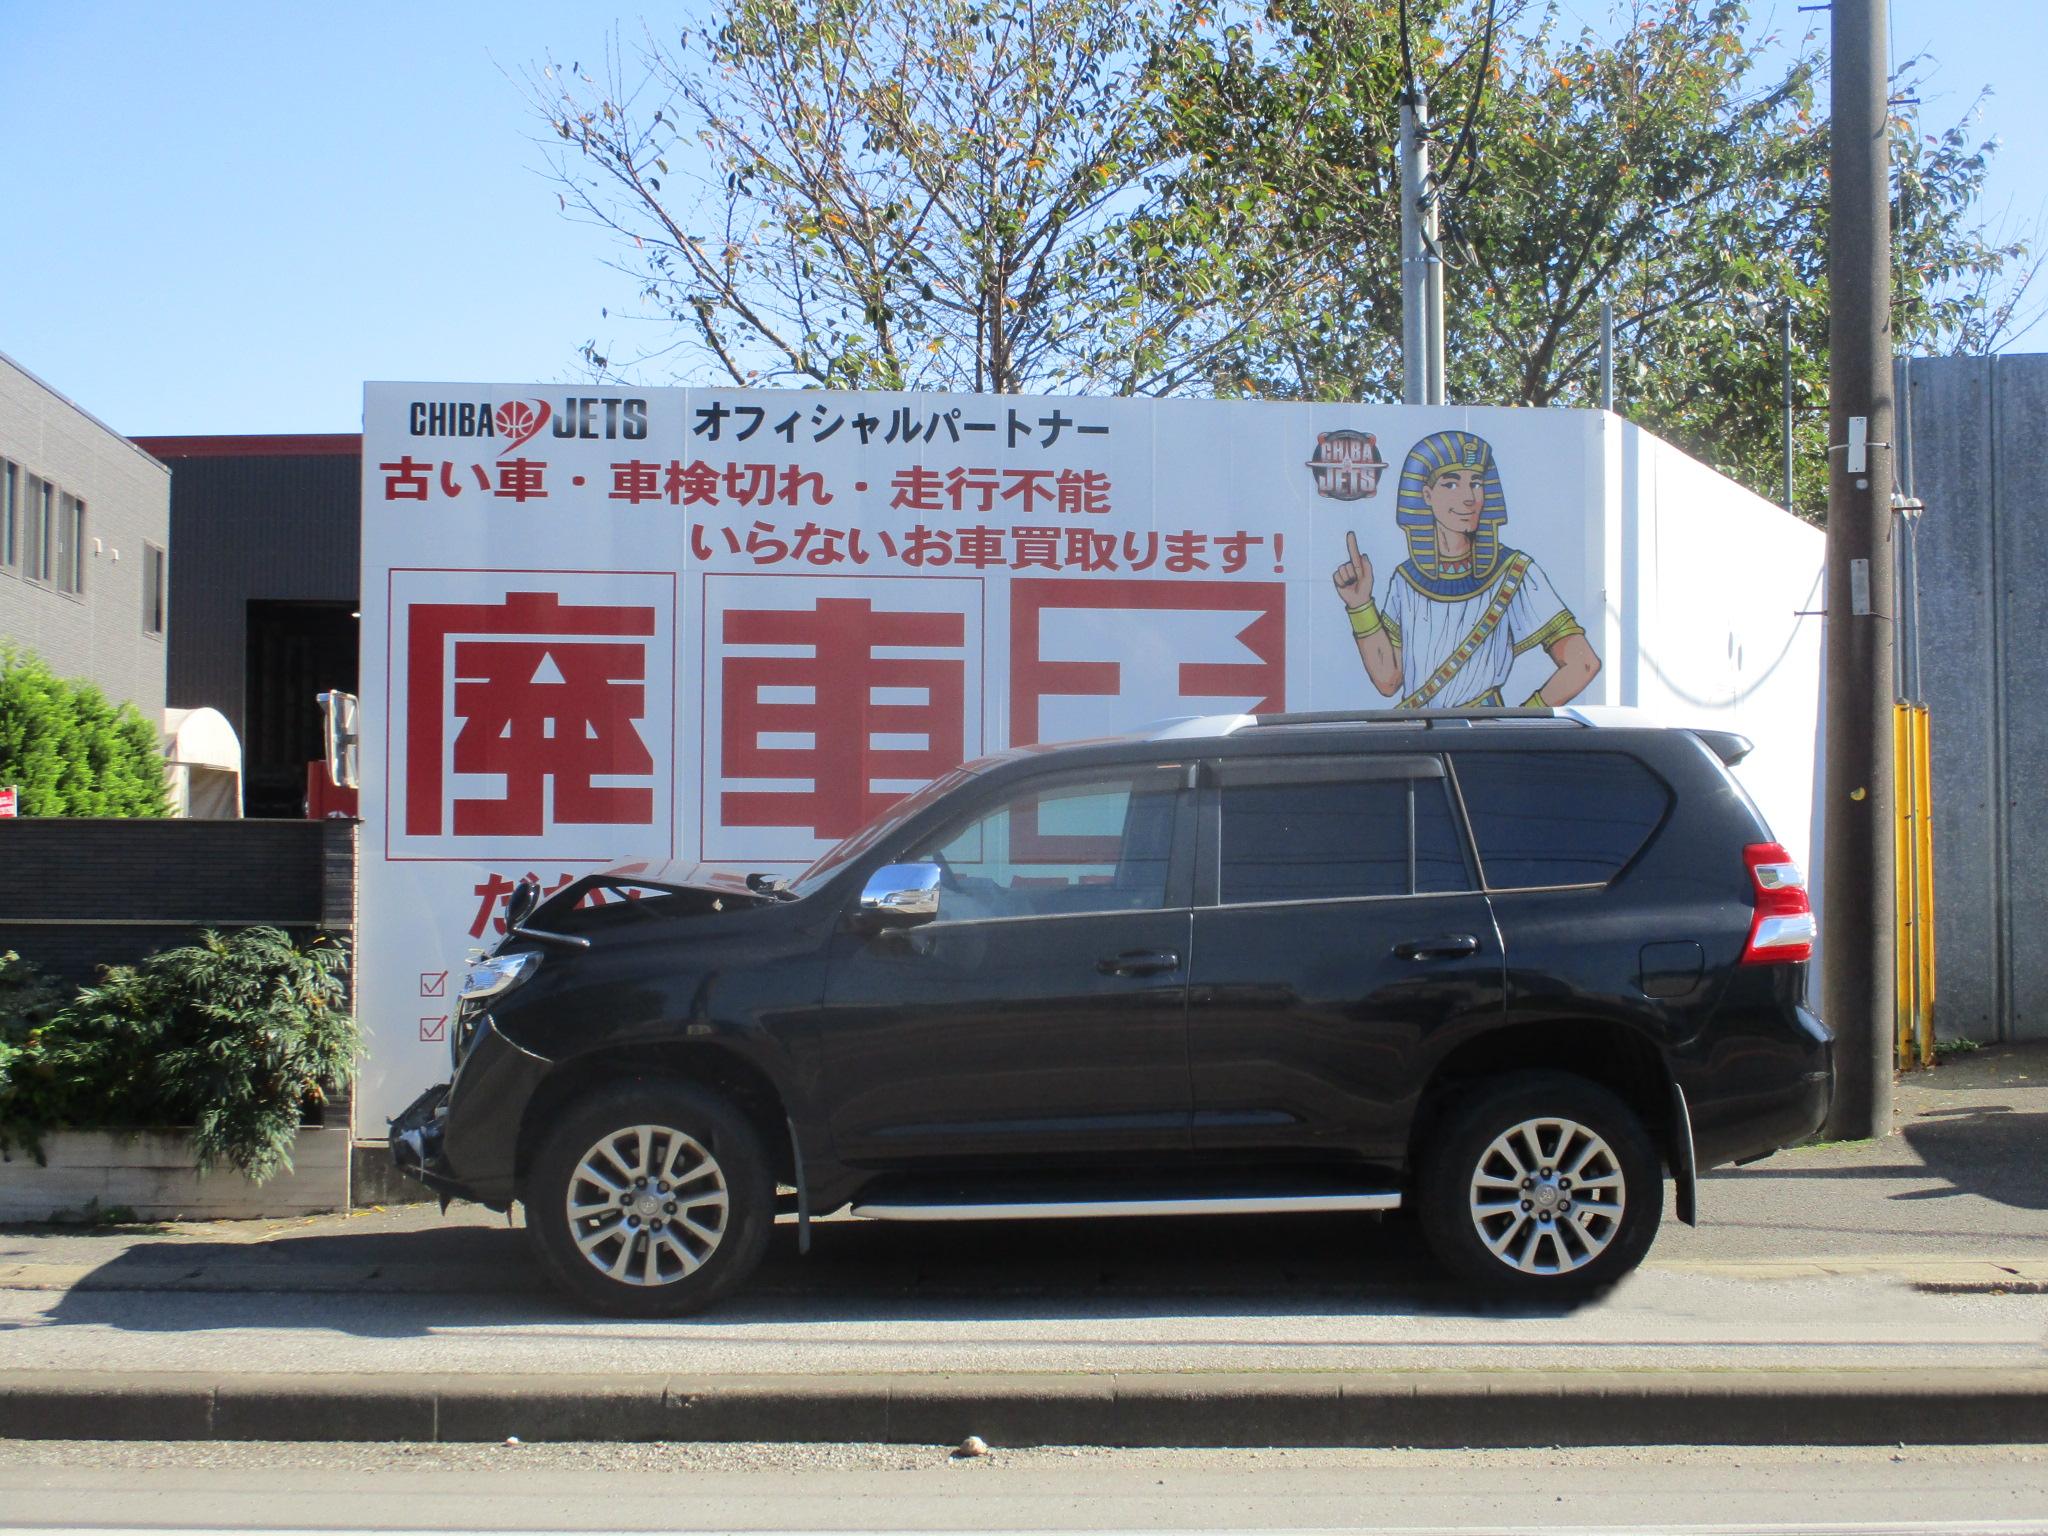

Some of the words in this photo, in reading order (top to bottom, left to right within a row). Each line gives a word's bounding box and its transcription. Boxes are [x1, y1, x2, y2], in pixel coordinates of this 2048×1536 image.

[410, 401, 495, 438] CHIBA
[552, 397, 648, 440] JETS
[692, 401, 1110, 449] オフィシャルパートナー
[1321, 439, 1374, 463] CHIBA
[1319, 467, 1377, 495] JETS
